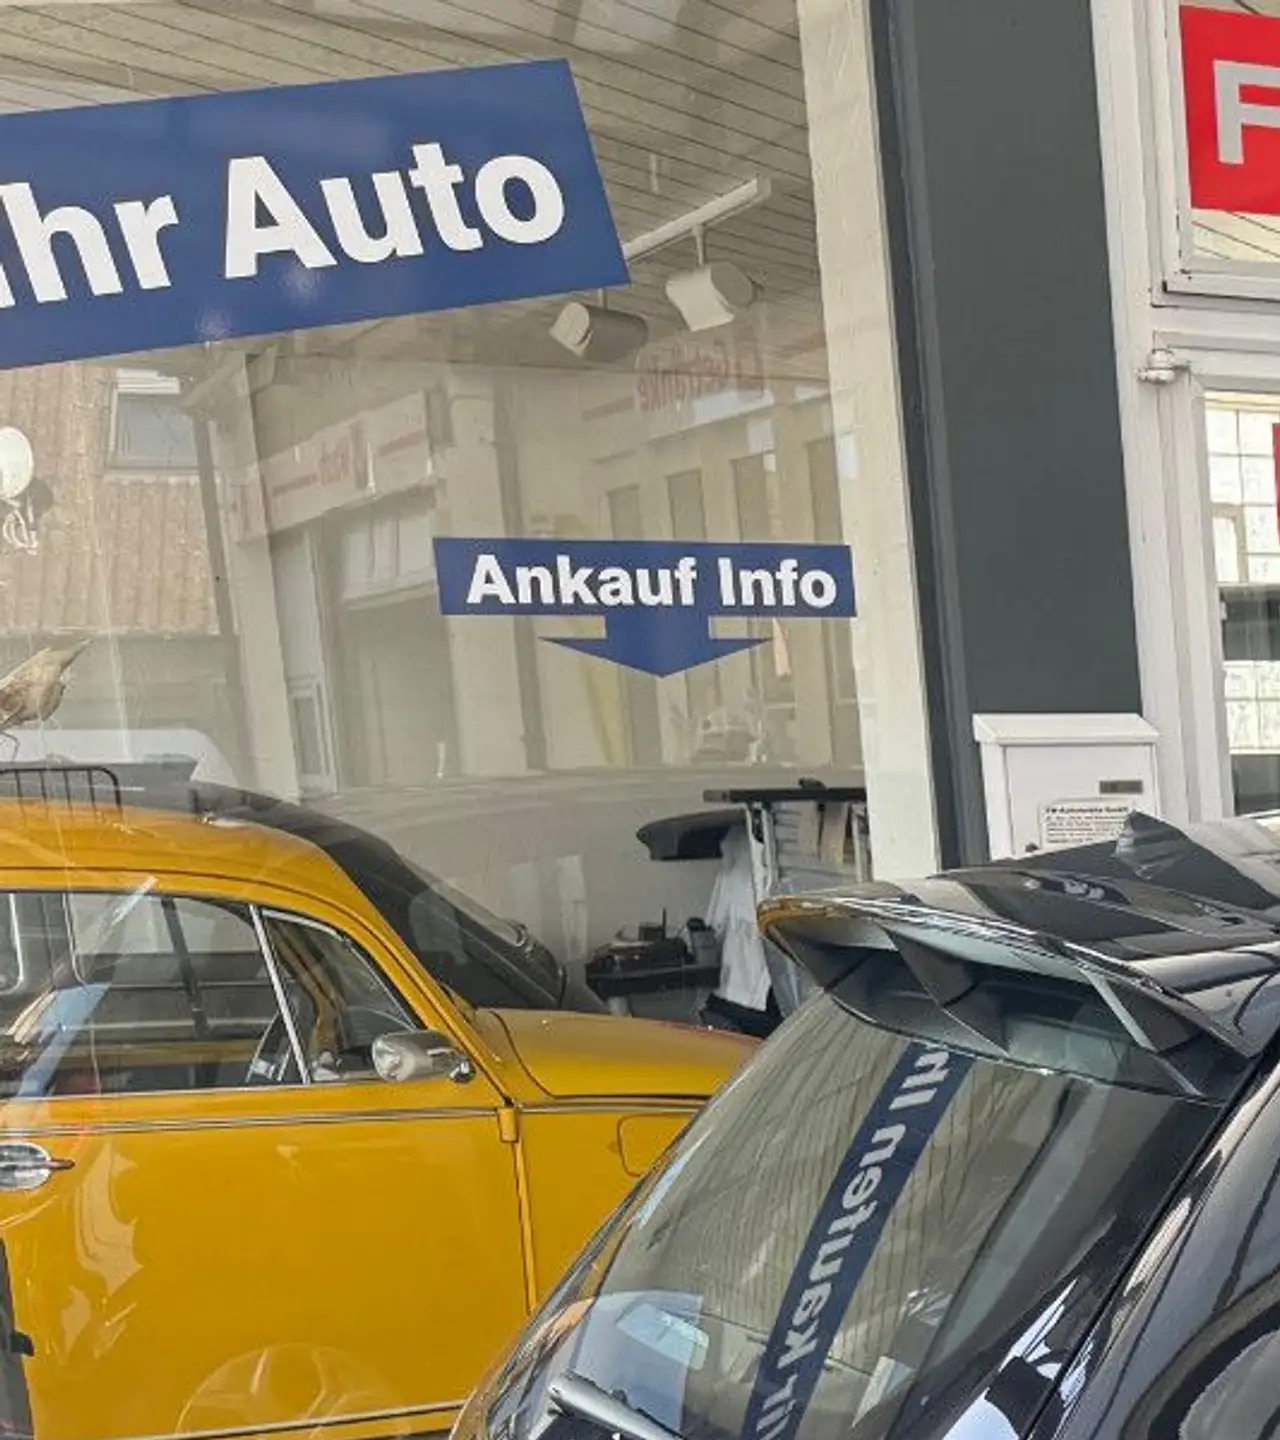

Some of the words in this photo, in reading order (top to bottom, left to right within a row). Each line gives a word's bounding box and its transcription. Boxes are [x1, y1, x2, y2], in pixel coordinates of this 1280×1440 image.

[223, 142, 567, 280] Auto
[466, 555, 697, 606] Ankauf
[719, 558, 839, 608] Info
